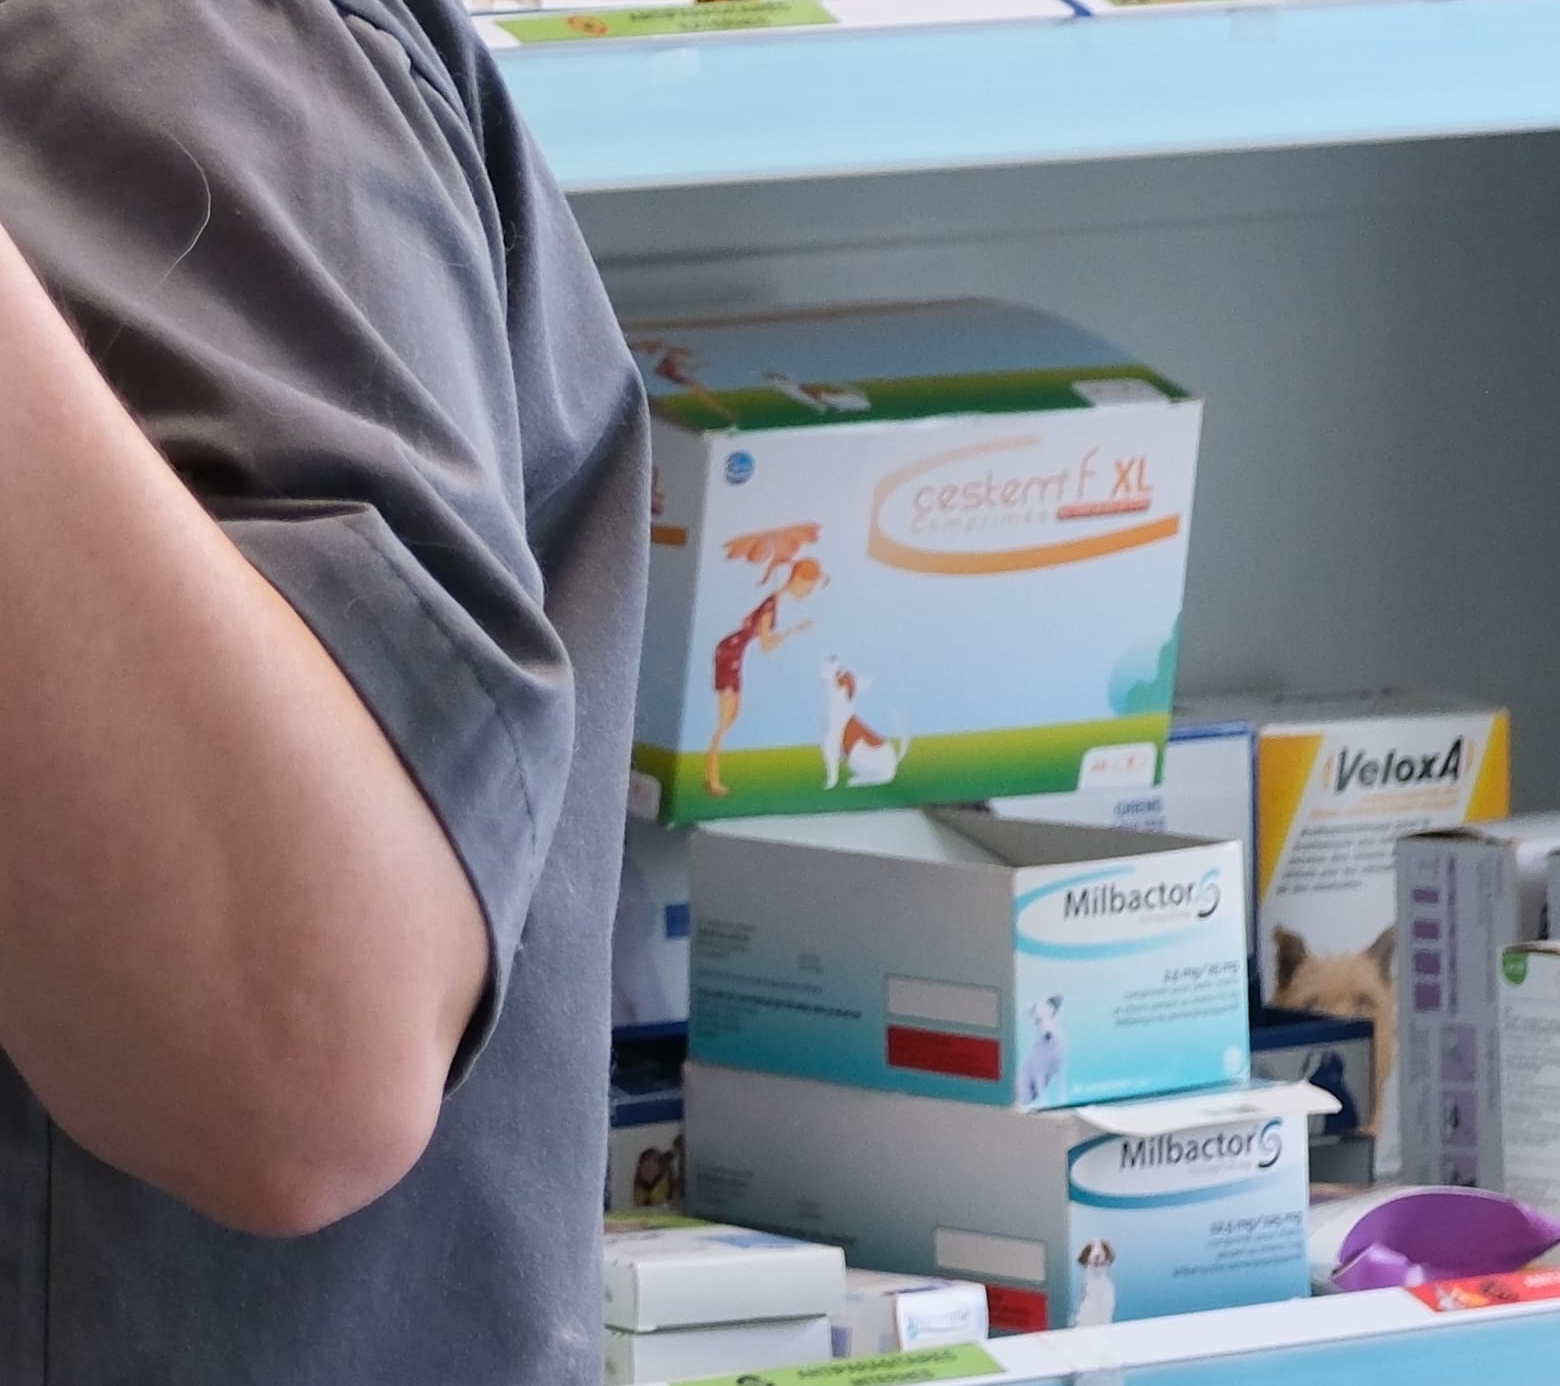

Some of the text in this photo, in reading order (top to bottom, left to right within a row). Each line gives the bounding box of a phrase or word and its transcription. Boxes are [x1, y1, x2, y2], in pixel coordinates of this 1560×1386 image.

[1110, 454, 1154, 497] XL
[1335, 735, 1466, 796] VeloxA
[1063, 879, 1196, 922] Milbactor
[1120, 1128, 1256, 1173] Milbactor
